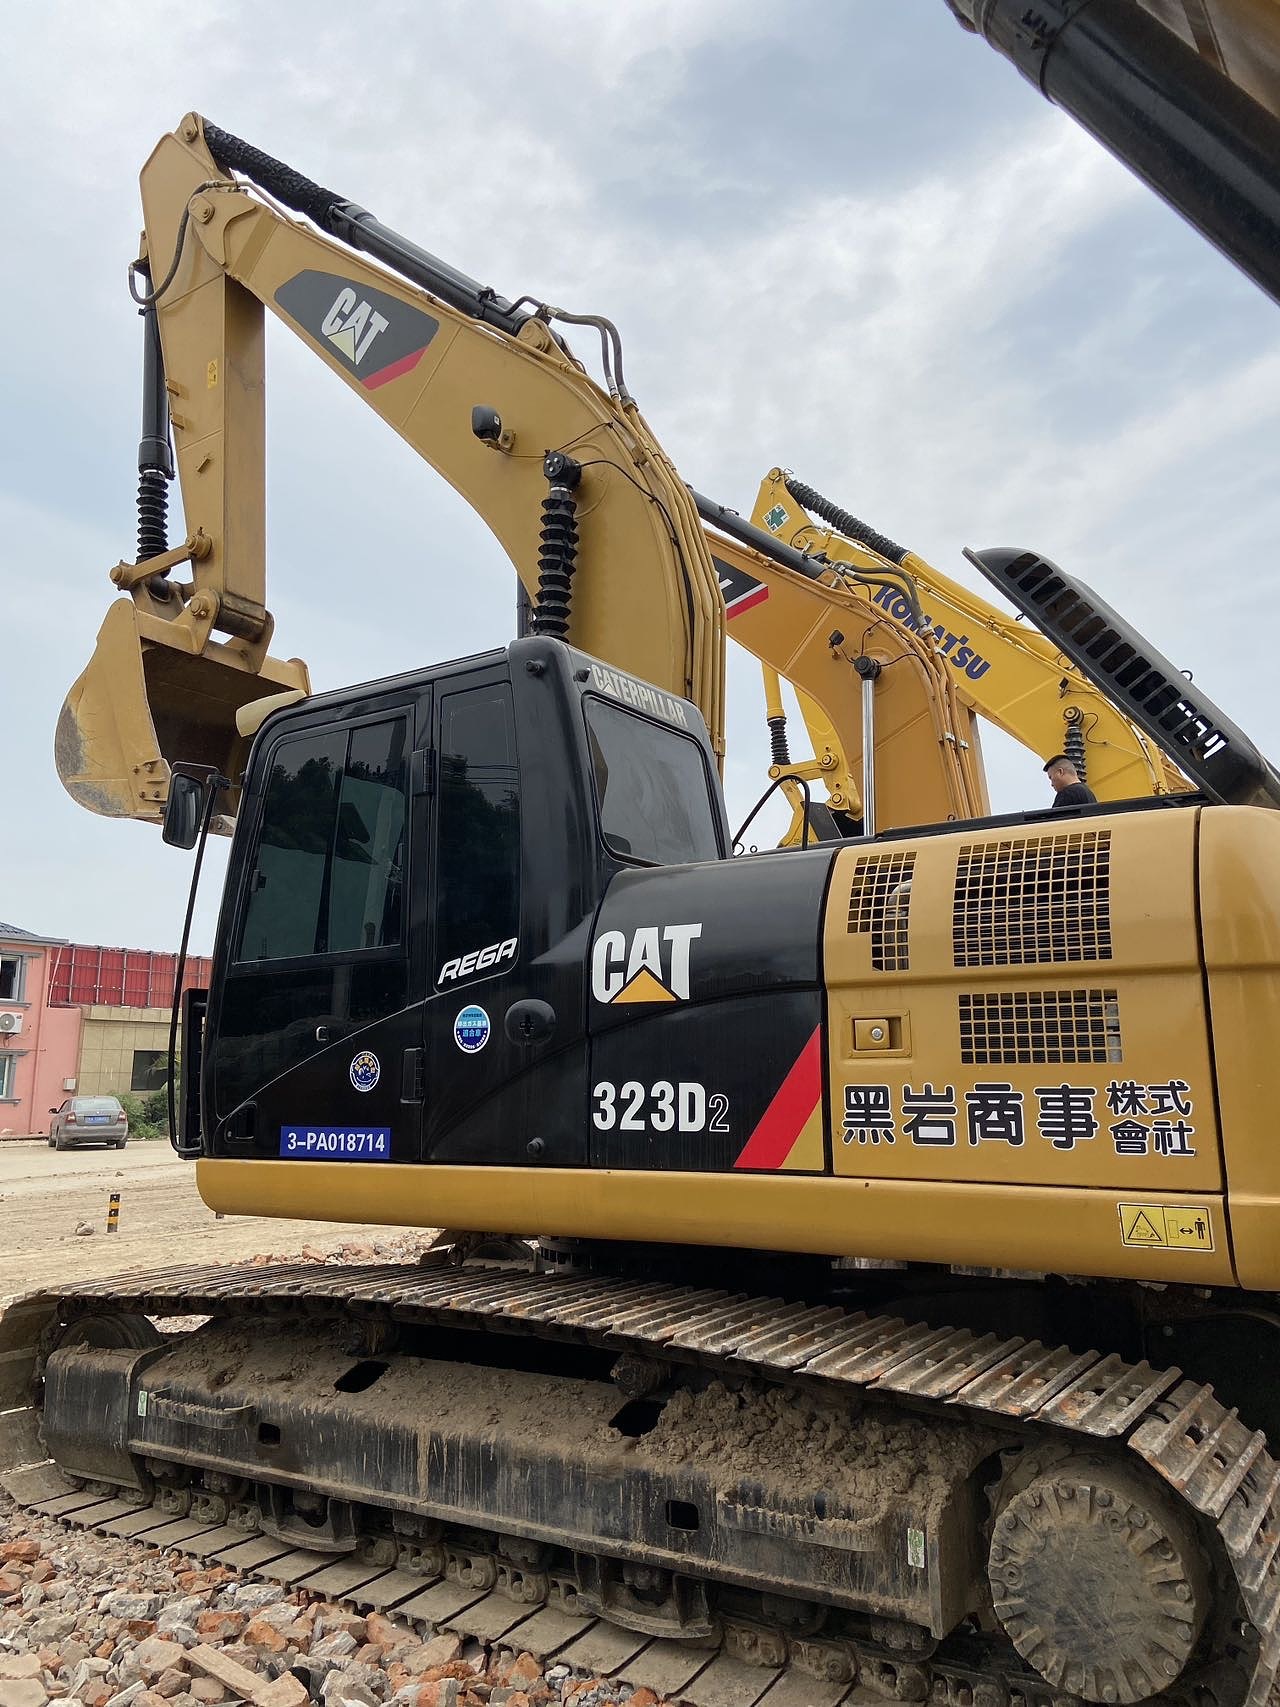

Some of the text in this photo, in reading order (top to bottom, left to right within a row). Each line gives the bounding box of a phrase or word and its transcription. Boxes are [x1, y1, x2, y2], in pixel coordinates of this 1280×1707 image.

[321, 287, 390, 366] CAT
[590, 663, 689, 728] CATERPILLAR
[437, 937, 518, 985] REGA
[592, 922, 703, 1004] CAT
[1106, 1080, 1194, 1117] 株式
[287, 1131, 385, 1152] 3-PA018714
